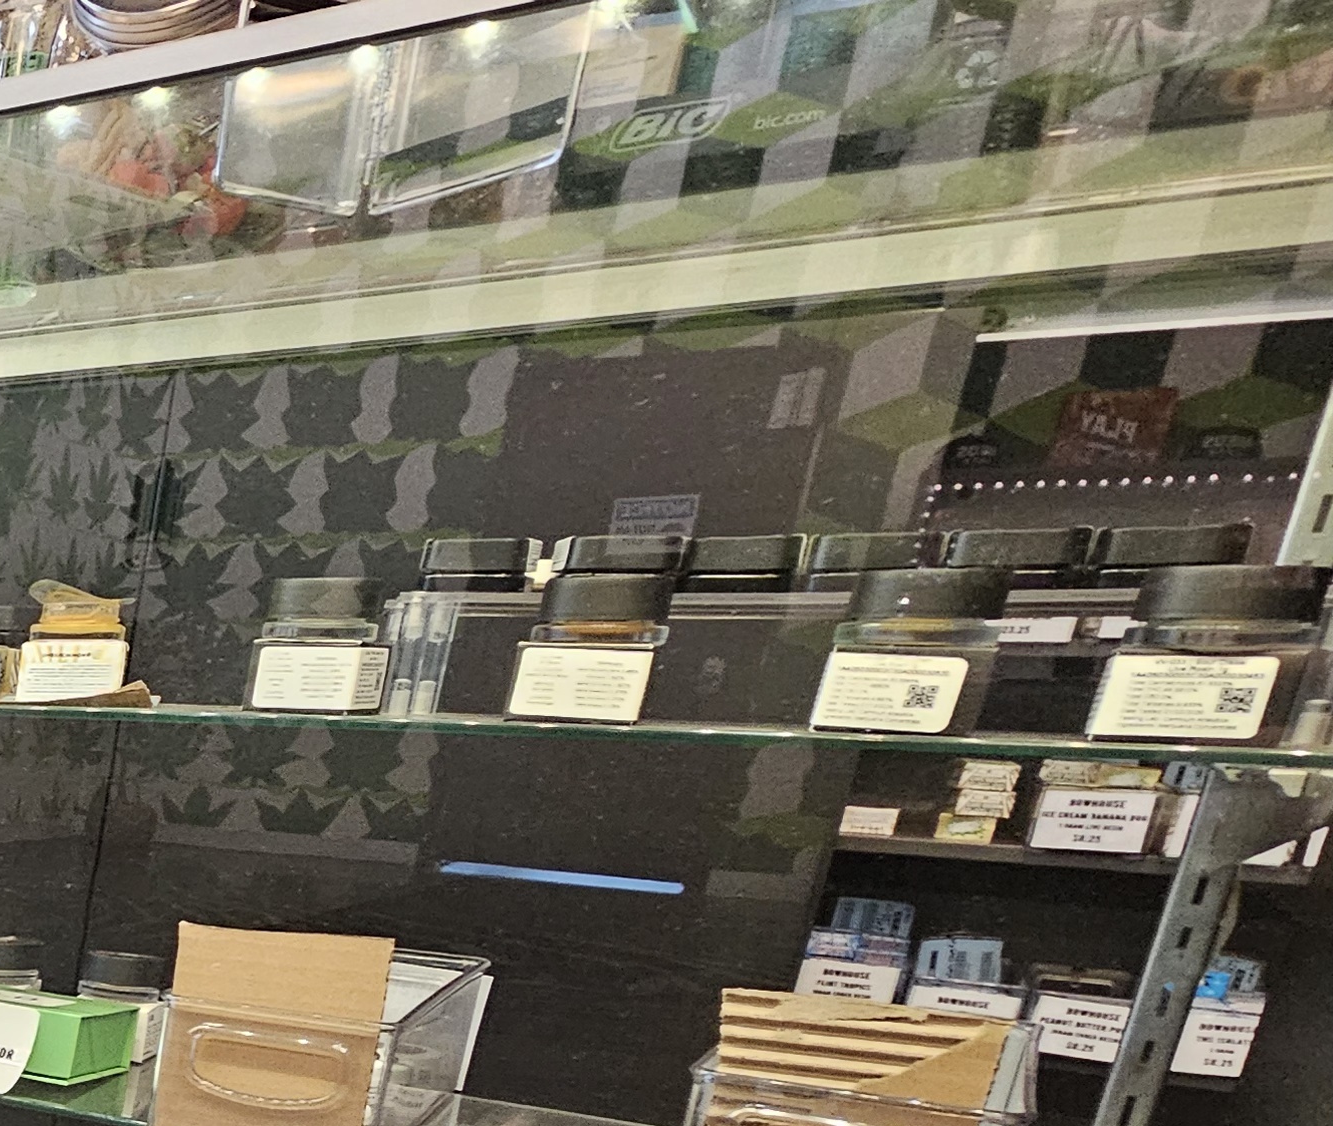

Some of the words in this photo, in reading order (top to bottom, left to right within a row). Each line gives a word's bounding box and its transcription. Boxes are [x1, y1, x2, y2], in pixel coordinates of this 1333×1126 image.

[619, 103, 727, 146] BIC
[753, 108, 827, 130] bic.com
[1069, 799, 1128, 809] BOWHOUSE
[937, 996, 990, 1010] BOWHOUSE
